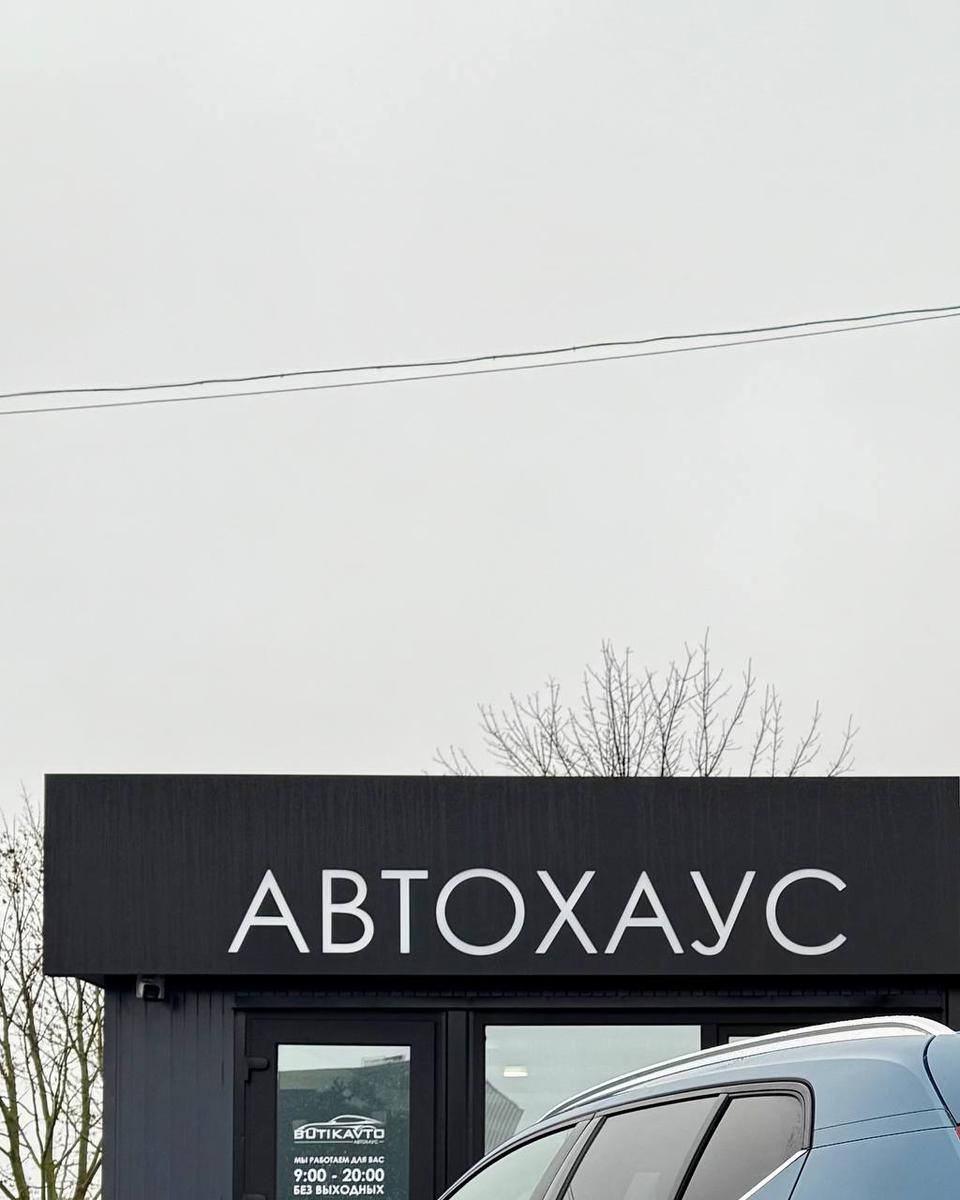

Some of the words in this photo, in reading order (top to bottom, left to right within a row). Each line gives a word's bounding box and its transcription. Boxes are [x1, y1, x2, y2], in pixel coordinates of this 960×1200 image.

[228, 868, 848, 956] АВТОХАУС
[293, 1128, 385, 1140] BUTIKAVTO
[310, 1156, 349, 1164] РАБОТАЕМ
[368, 1156, 385, 1164] ВАС
[293, 1168, 327, 1182] 9:00
[342, 1168, 385, 1182] 20:00
[293, 1184, 313, 1195] БЕЗ
[315, 1184, 385, 1197] ВЫХОДНЫХ
